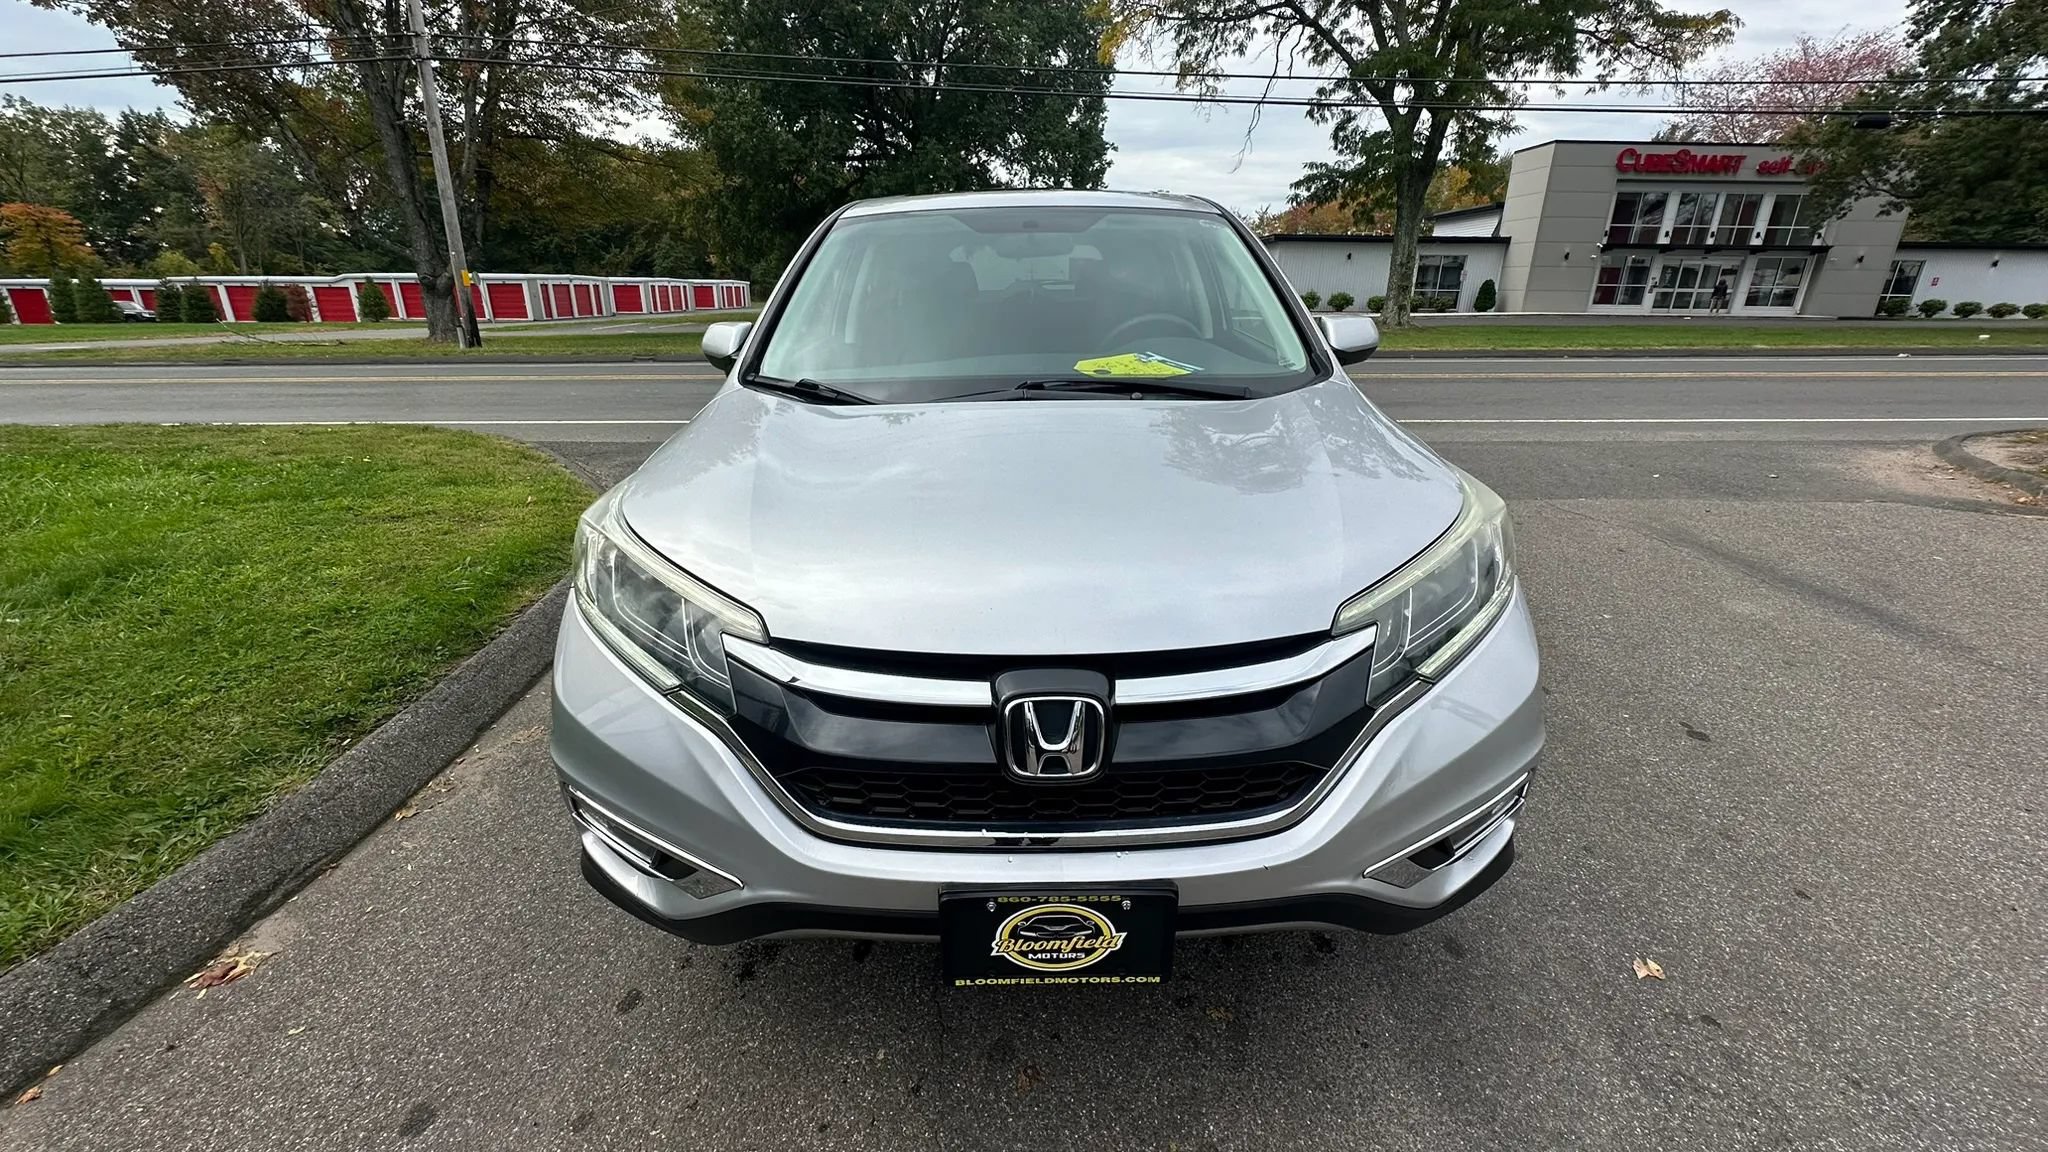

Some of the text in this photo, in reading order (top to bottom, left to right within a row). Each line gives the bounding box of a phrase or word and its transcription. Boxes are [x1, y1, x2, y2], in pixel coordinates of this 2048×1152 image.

[998, 935, 1121, 953] Bloomfield
[1028, 952, 1085, 960] MOTORS
[955, 976, 1161, 987] BLOOMFIELDMOTORS.COM
